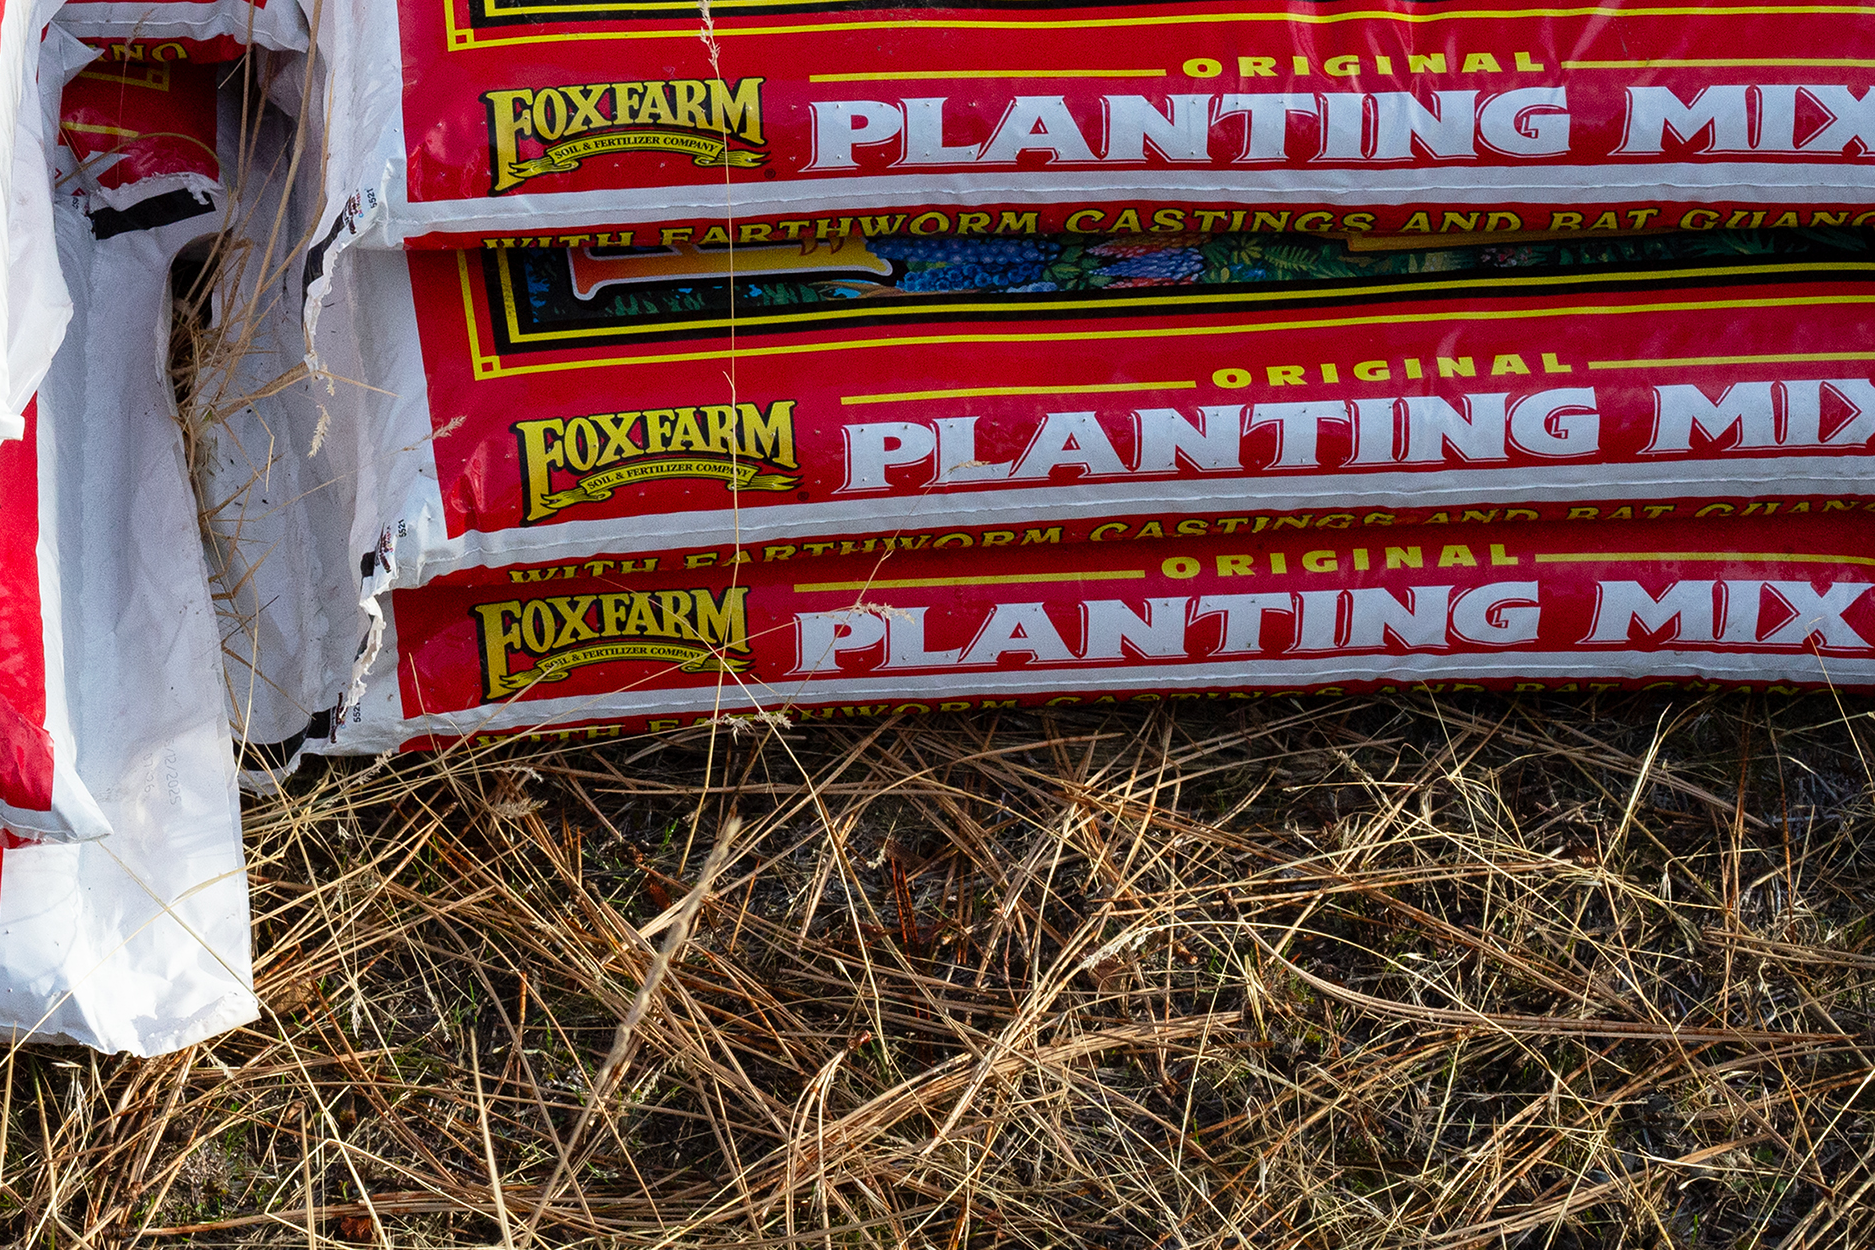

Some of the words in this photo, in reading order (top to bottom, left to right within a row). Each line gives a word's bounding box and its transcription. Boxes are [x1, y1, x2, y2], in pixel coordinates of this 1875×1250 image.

[1182, 51, 1545, 78] ORIGINAL
[480, 78, 767, 197] FOXFARM
[554, 146, 580, 159] SOIL
[594, 136, 660, 148] FERTILIZER
[663, 137, 718, 152] COMPANY
[799, 86, 1571, 172] PLANTING
[660, 210, 1039, 247] EARTHWORM
[1066, 208, 1375, 236] CASTINGS
[1407, 210, 1522, 234] AND
[1545, 207, 1659, 233] BAT
[1211, 353, 1573, 389] ORIGINAL
[511, 400, 798, 523] FOXFARM
[831, 387, 1600, 494] PLANTING
[1161, 544, 1520, 580] ORIGINAL
[469, 586, 752, 705] FOXFARM
[784, 580, 1542, 676] PLANTING
[1576, 579, 1875, 651] MIX
